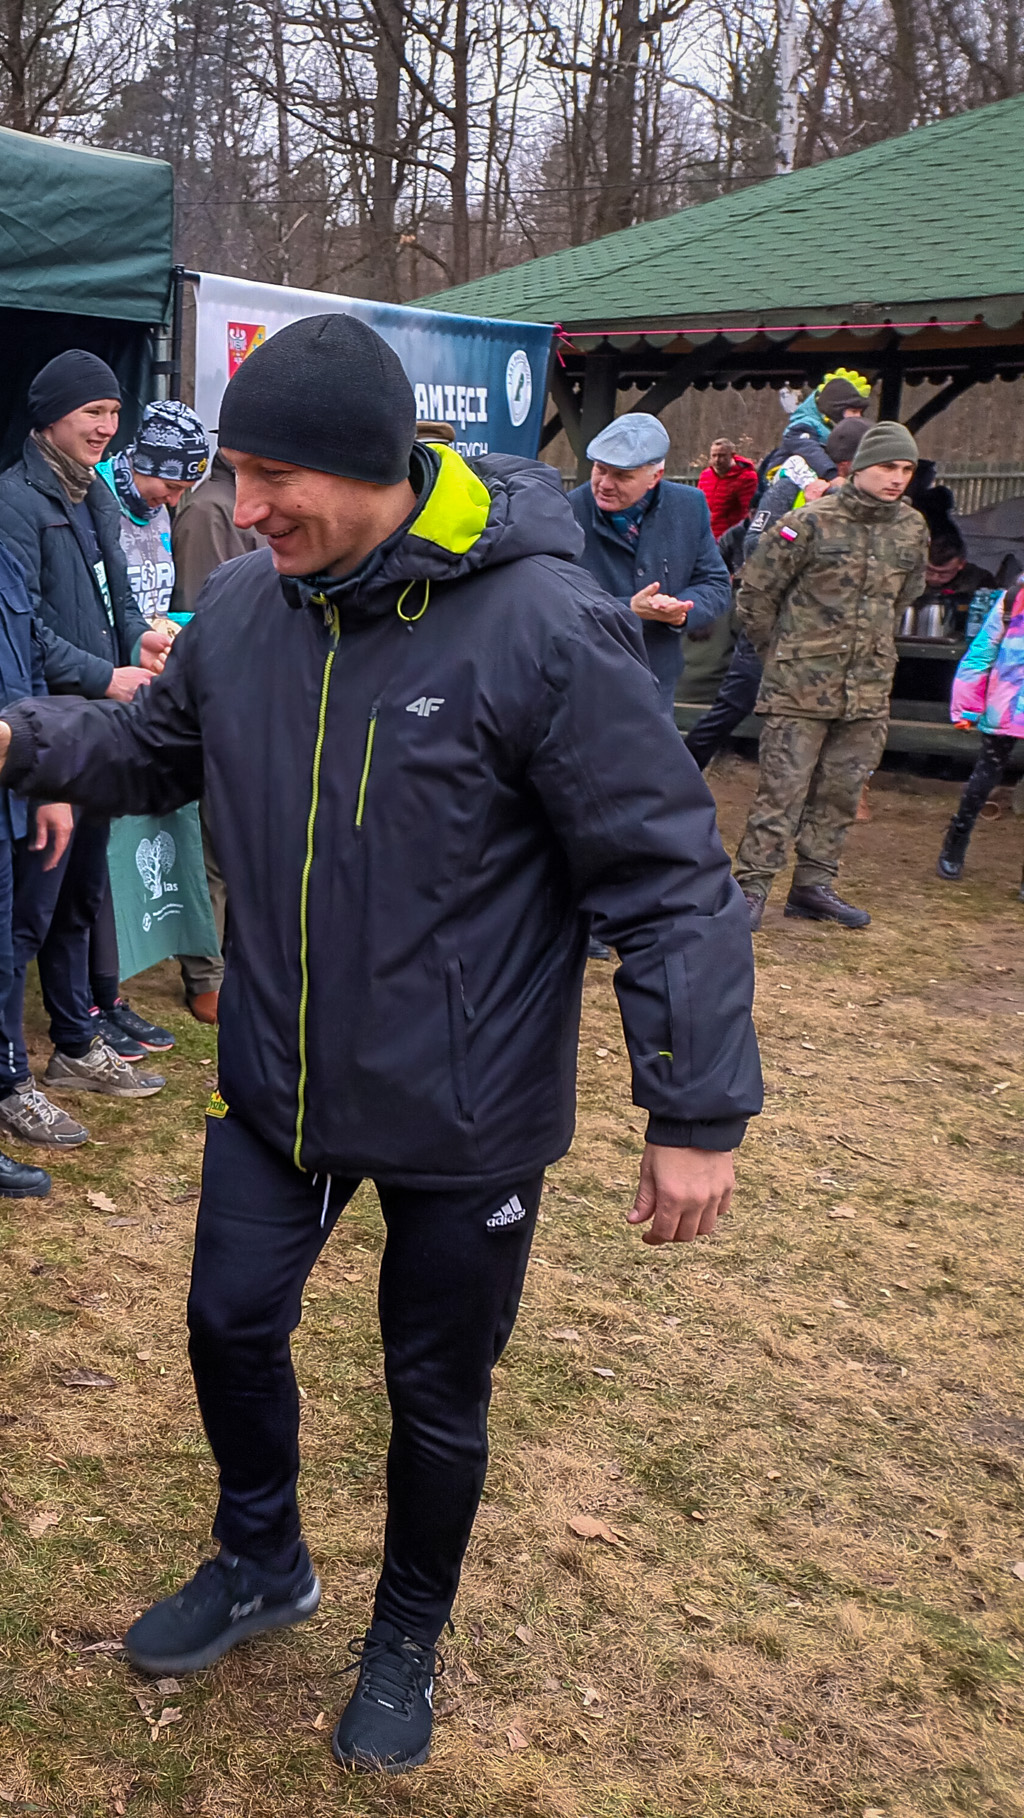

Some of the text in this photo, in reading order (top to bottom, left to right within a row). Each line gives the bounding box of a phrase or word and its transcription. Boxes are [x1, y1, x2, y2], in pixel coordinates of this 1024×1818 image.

[405, 696, 445, 717] 4F
[163, 881, 178, 892] las
[486, 1208, 526, 1227] adidas
